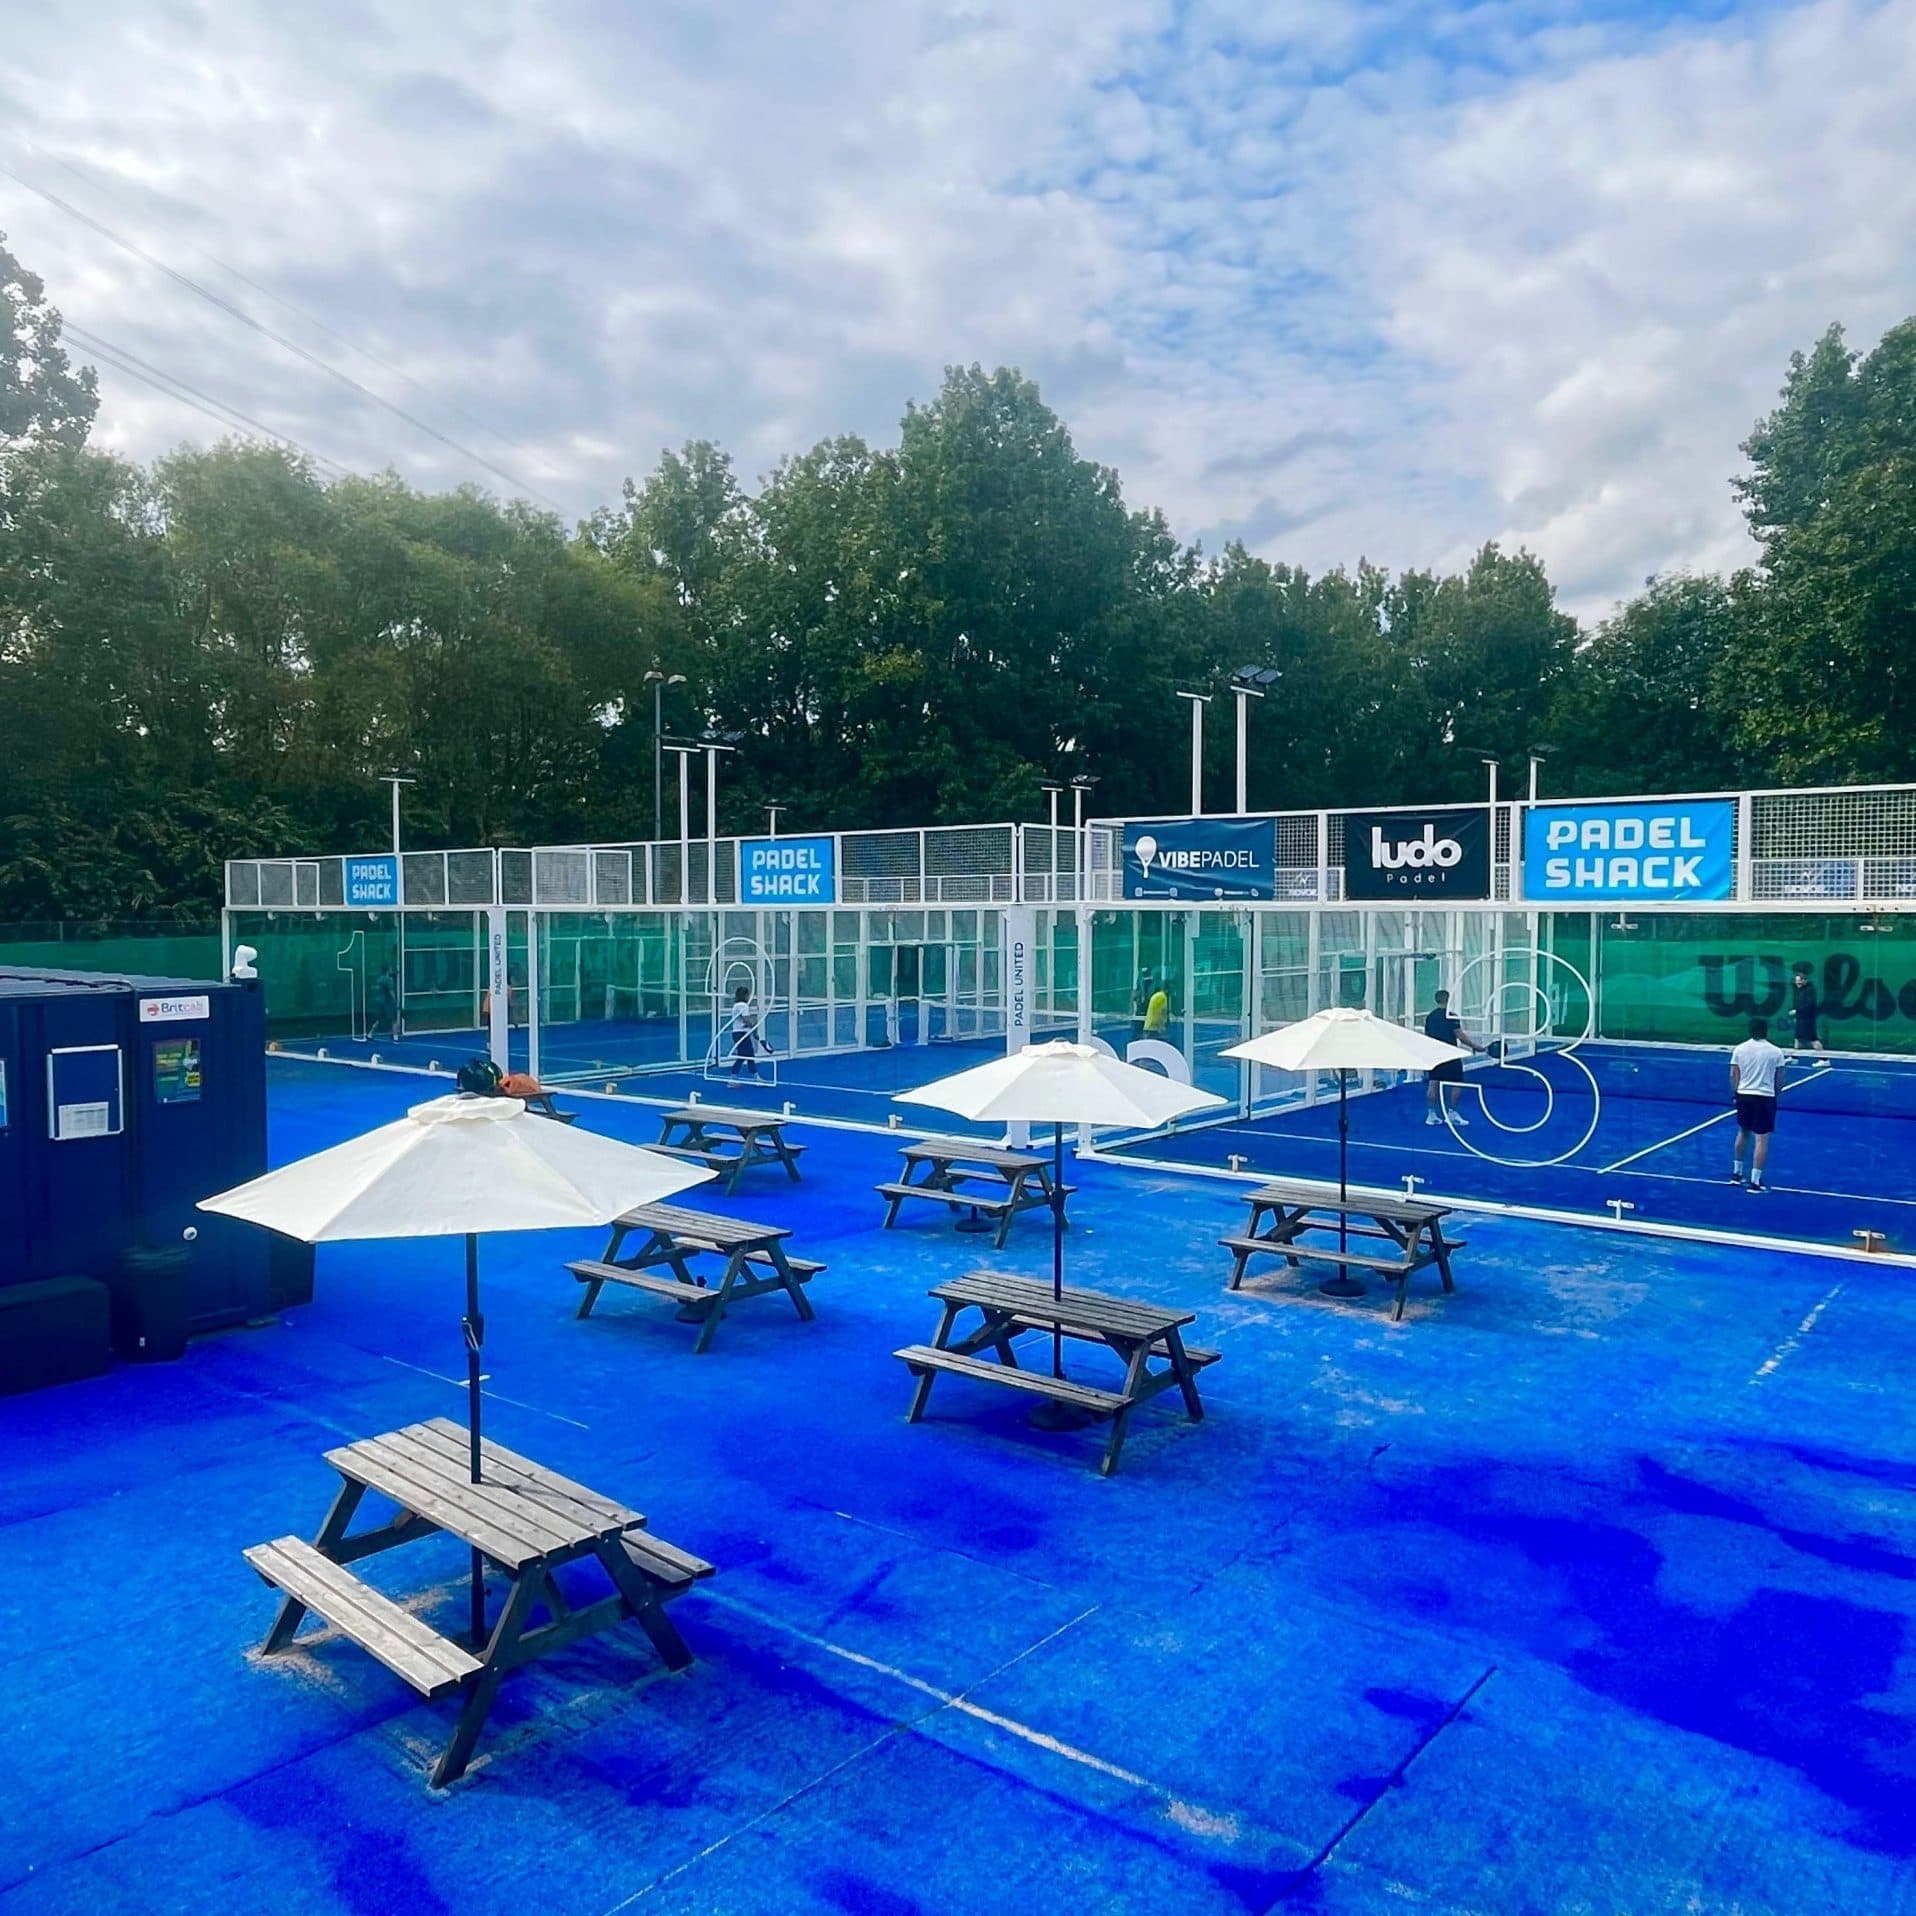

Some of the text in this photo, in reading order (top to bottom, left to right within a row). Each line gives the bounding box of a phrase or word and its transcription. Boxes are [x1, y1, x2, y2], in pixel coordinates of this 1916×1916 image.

[1371, 823, 1462, 869] ludo
[1546, 816, 1706, 850] PADEL
[352, 864, 392, 880] PADEL
[752, 847, 822, 870] PADEL
[1158, 850, 1259, 868] VIBEPADEL
[1545, 855, 1704, 888] SHACK
[352, 884, 391, 899] SHACK
[750, 873, 820, 895] SHACK
[1386, 871, 1446, 884] Padel
[337, 930, 367, 1042] 1
[1014, 942, 1024, 1026] PADEL UNITED
[703, 936, 776, 1087] 2
[1439, 947, 1600, 1167] 3
